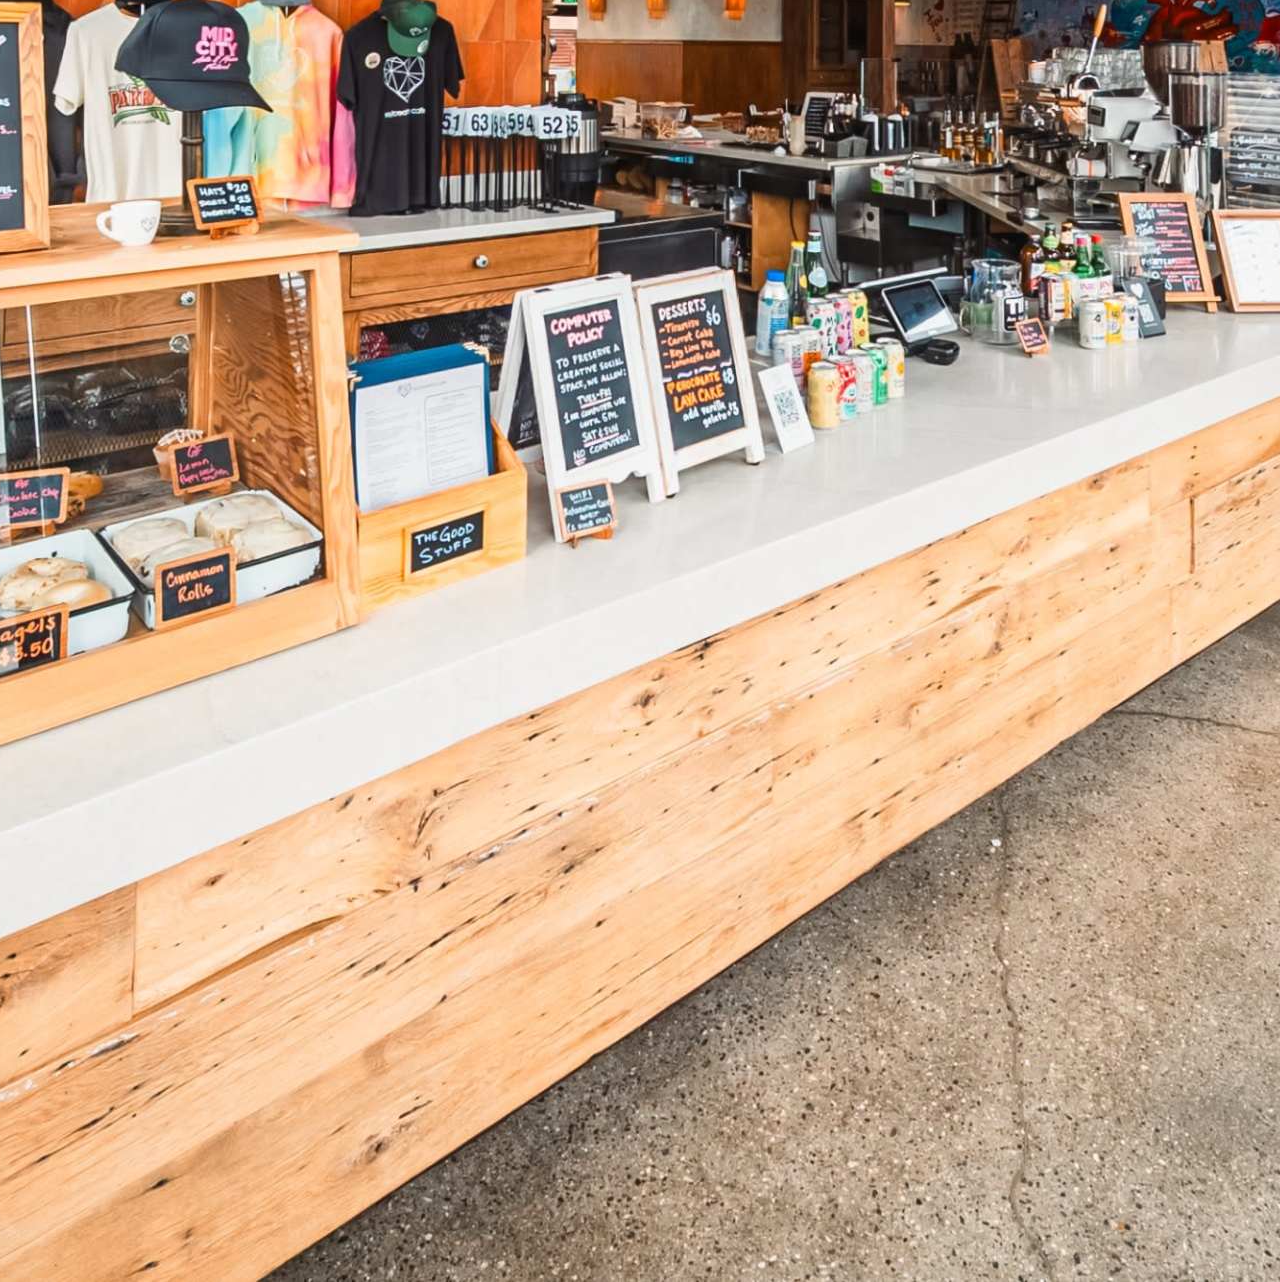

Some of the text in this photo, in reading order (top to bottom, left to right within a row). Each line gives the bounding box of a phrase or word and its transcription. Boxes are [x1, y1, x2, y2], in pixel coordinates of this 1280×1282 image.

[201, 25, 235, 43] MID
[195, 42, 238, 58] CITY
[442, 112, 460, 131] 51
[471, 113, 489, 131] 63
[543, 116, 563, 134] 52
[199, 186, 226, 197] HATS
[658, 298, 707, 321] DESSERTS
[706, 305, 721, 326] $6
[550, 308, 612, 335] COMPUTER
[567, 326, 605, 348] POLICY
[555, 343, 620, 370] TO PRESERVE A
[557, 357, 624, 383] CREATIVE SOCIAL
[675, 367, 735, 392] CHOCOLATE $8
[560, 381, 587, 394] SPACE,
[673, 383, 725, 413] LAVA CAKE
[573, 429, 632, 461] NO COMPUTERS!
[414, 522, 475, 545] THE GOOD
[419, 537, 473, 564] STUFF
[165, 561, 225, 590] Cinnamon
[177, 582, 214, 606] Rolls
